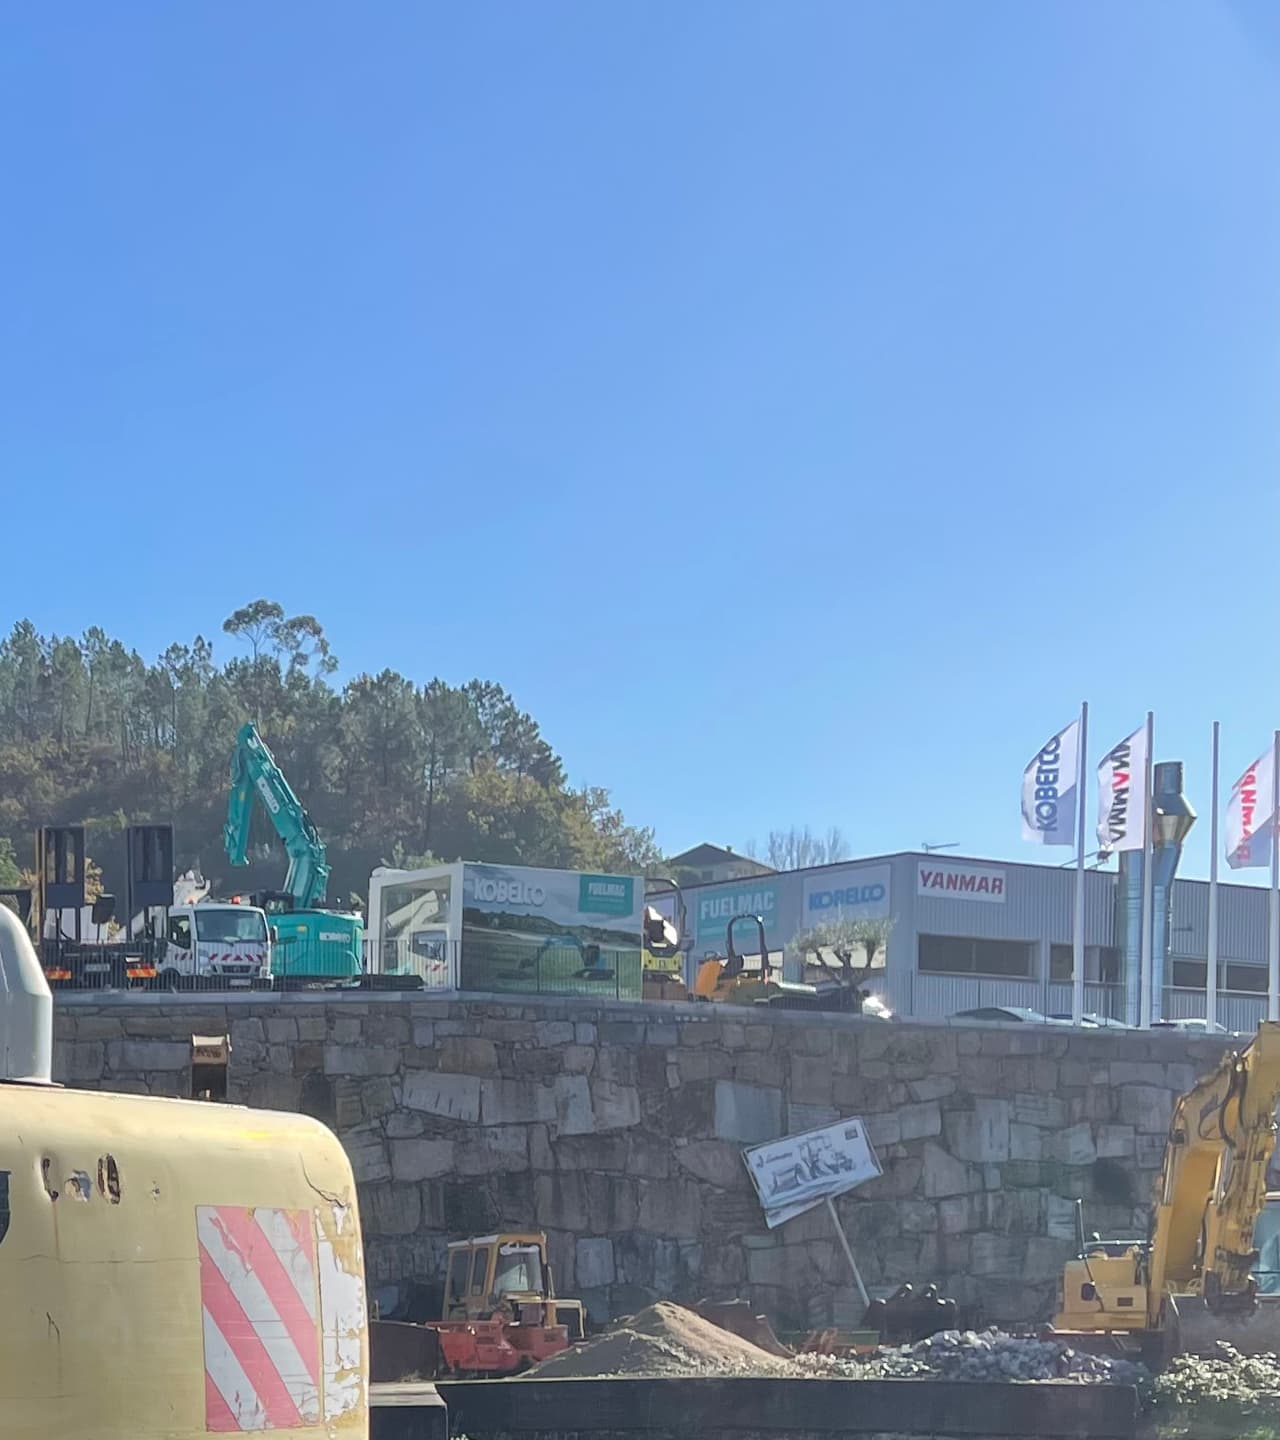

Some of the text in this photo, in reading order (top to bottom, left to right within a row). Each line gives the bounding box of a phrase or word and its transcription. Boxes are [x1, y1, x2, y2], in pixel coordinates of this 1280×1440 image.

[1034, 735, 1060, 832] KOBELCO
[473, 878, 547, 907] KOBELCO
[920, 869, 1004, 895] YANMAR
[700, 891, 774, 920] FUELMAC
